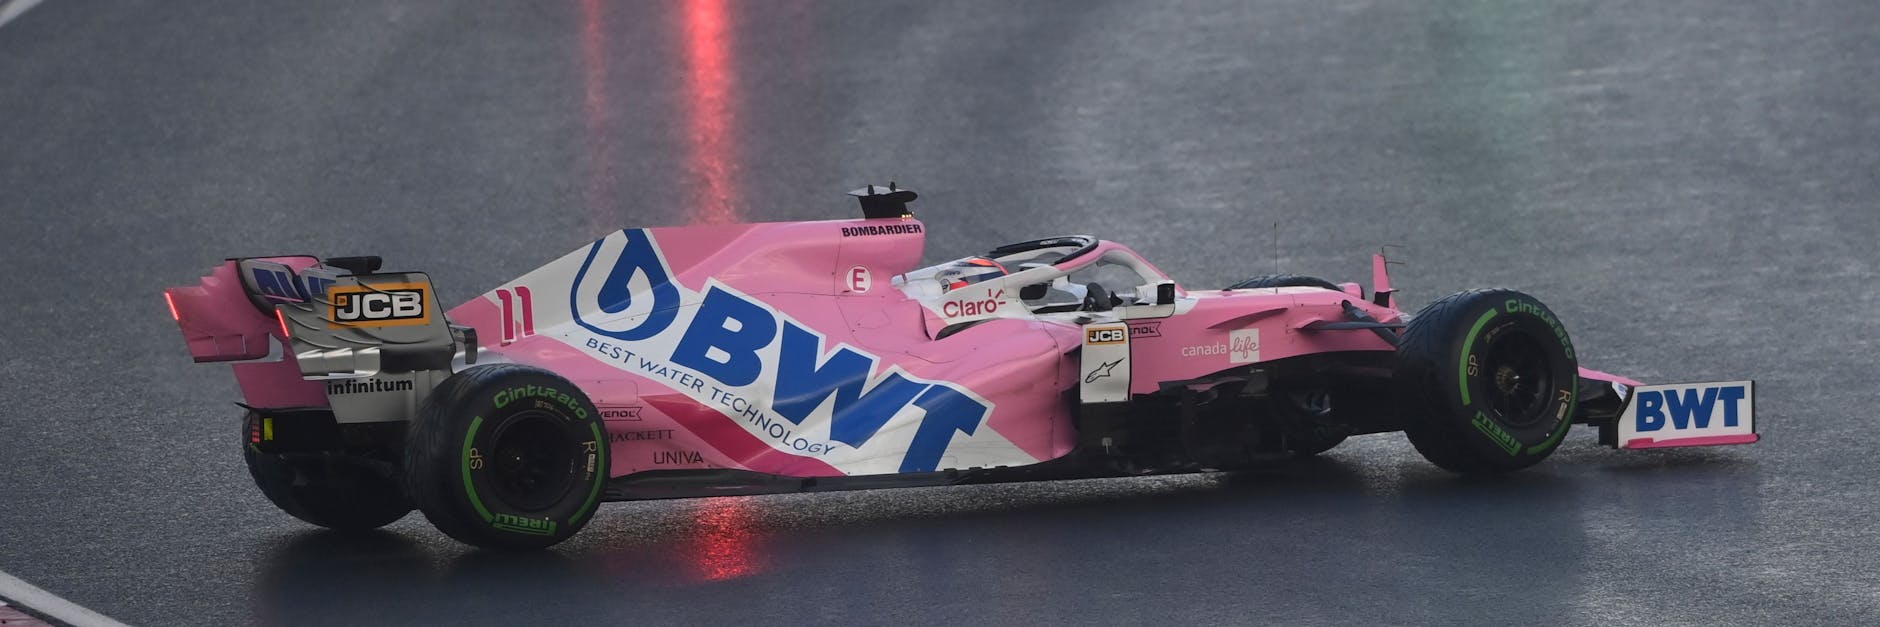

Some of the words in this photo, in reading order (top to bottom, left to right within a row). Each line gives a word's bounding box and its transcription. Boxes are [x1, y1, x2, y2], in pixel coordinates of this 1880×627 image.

[841, 224, 922, 237] BOMBARDIER
[852, 268, 866, 291] E
[337, 292, 422, 320] JCB
[495, 286, 535, 342] 11
[943, 294, 1001, 318] Claro
[1089, 330, 1124, 342] JCB
[1182, 342, 1227, 357] canada
[1230, 337, 1260, 359] life
[1468, 354, 1478, 377] SP
[328, 378, 413, 396] infinitum
[669, 286, 988, 473] BWT
[494, 384, 588, 420] Cinturato
[586, 337, 636, 364] BEST
[640, 357, 704, 393] WATER
[711, 386, 836, 456] TECHNOLOGY
[1636, 386, 1745, 432] BWT
[1472, 410, 1523, 457] PIRELLI
[470, 447, 483, 470] SP
[653, 451, 704, 464] UNIVA
[493, 513, 557, 536] PIRELLI
